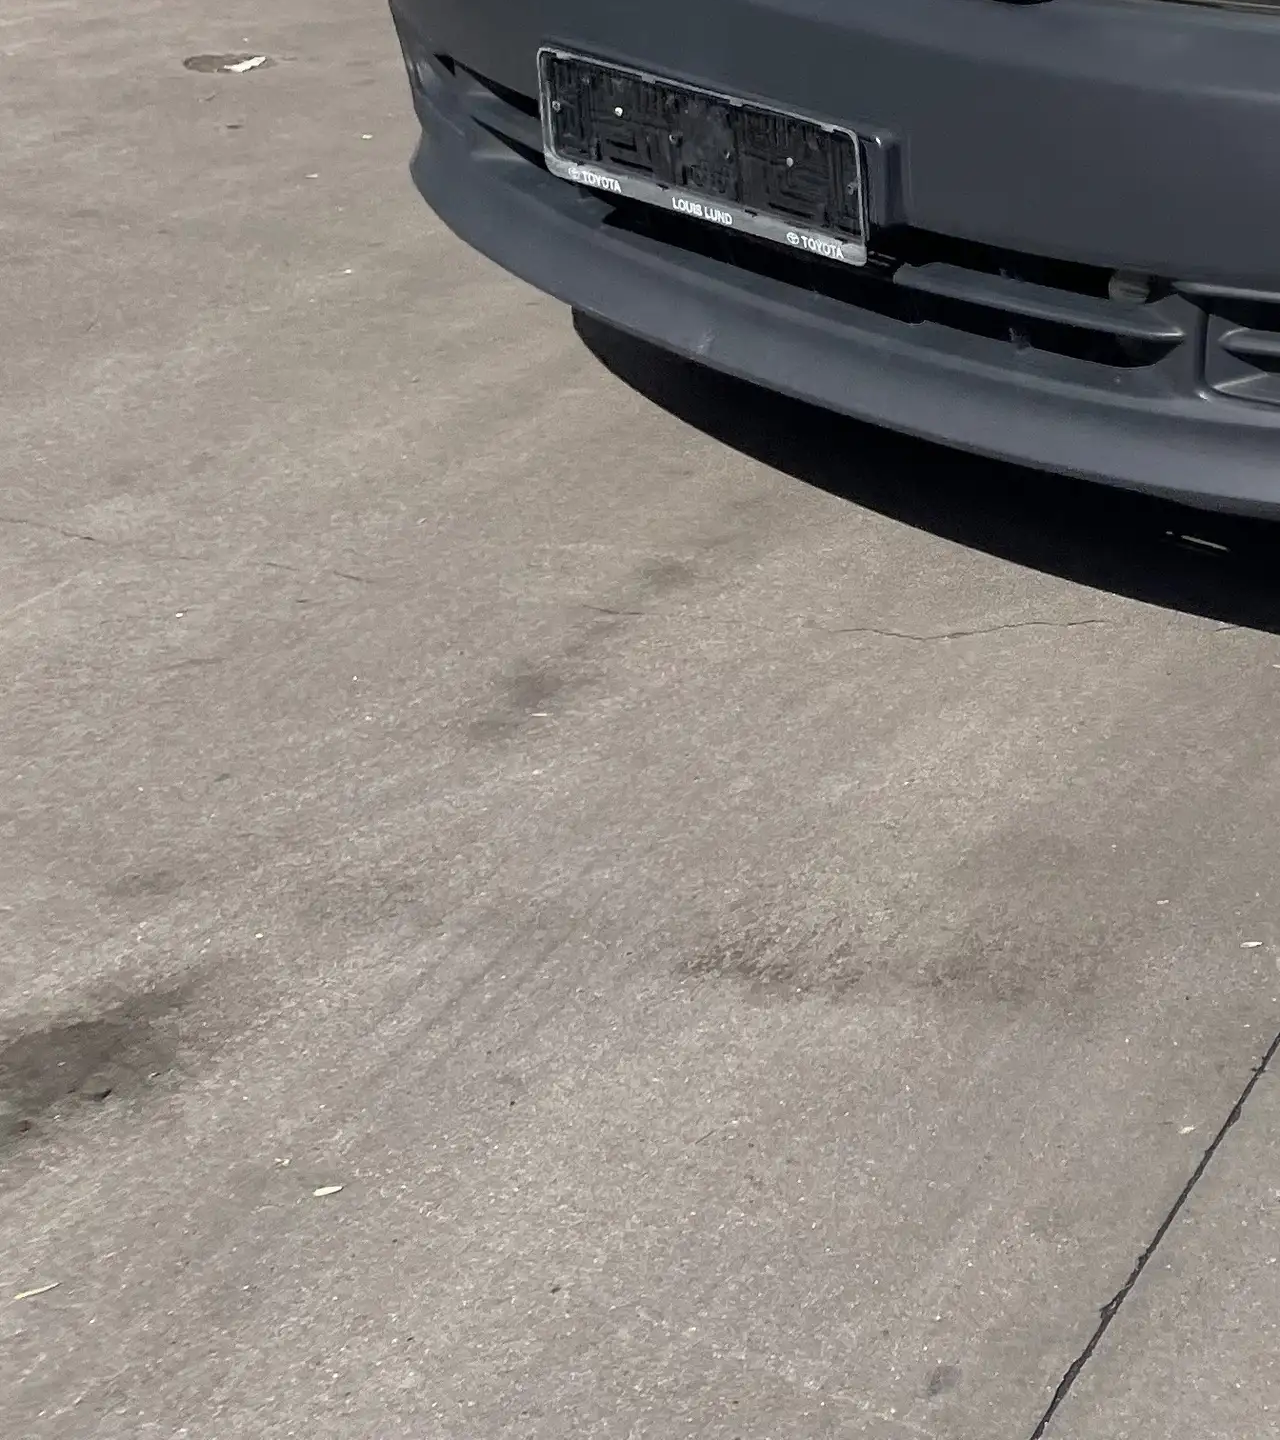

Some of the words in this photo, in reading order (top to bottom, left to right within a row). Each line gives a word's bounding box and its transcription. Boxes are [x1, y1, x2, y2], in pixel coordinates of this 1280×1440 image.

[581, 170, 622, 194] TOYOTA
[671, 196, 703, 217] LOUIS
[704, 205, 733, 225] LUND
[800, 235, 845, 260] TOYOTA
